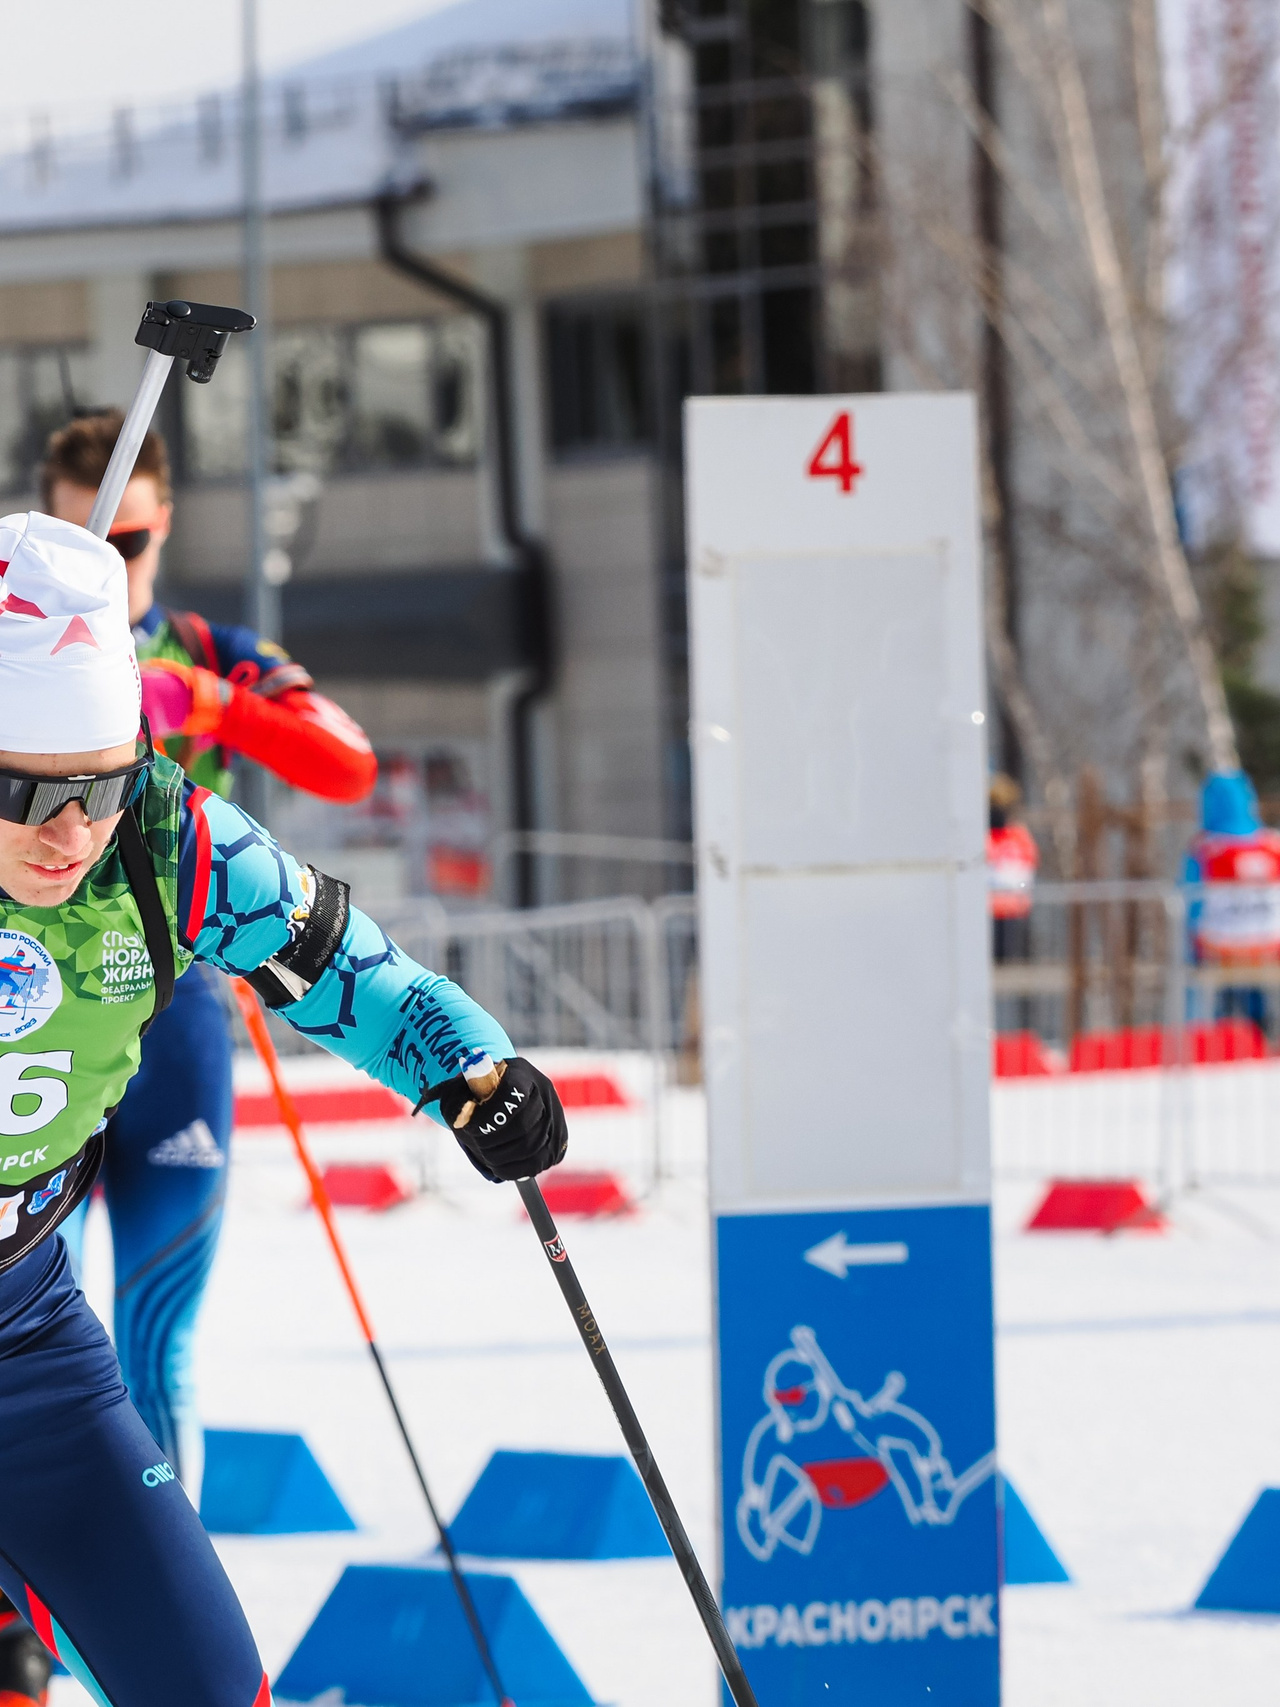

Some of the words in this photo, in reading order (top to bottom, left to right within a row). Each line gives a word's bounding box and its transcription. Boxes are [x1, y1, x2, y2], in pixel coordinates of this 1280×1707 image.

[808, 411, 862, 493] 4
[19, 935, 52, 967] РОССИИ
[102, 946, 150, 966] НОРМ
[102, 962, 154, 985] ЖИЗН
[101, 981, 152, 994] ФЕДЕРАЛЬН
[101, 993, 135, 1005] ПРОЕКТ
[14, 1017, 37, 1034] 2023
[478, 1087, 525, 1135] MOAX
[576, 1301, 607, 1355] MOAX
[725, 1594, 997, 1648] КРАСНОЯРСК
